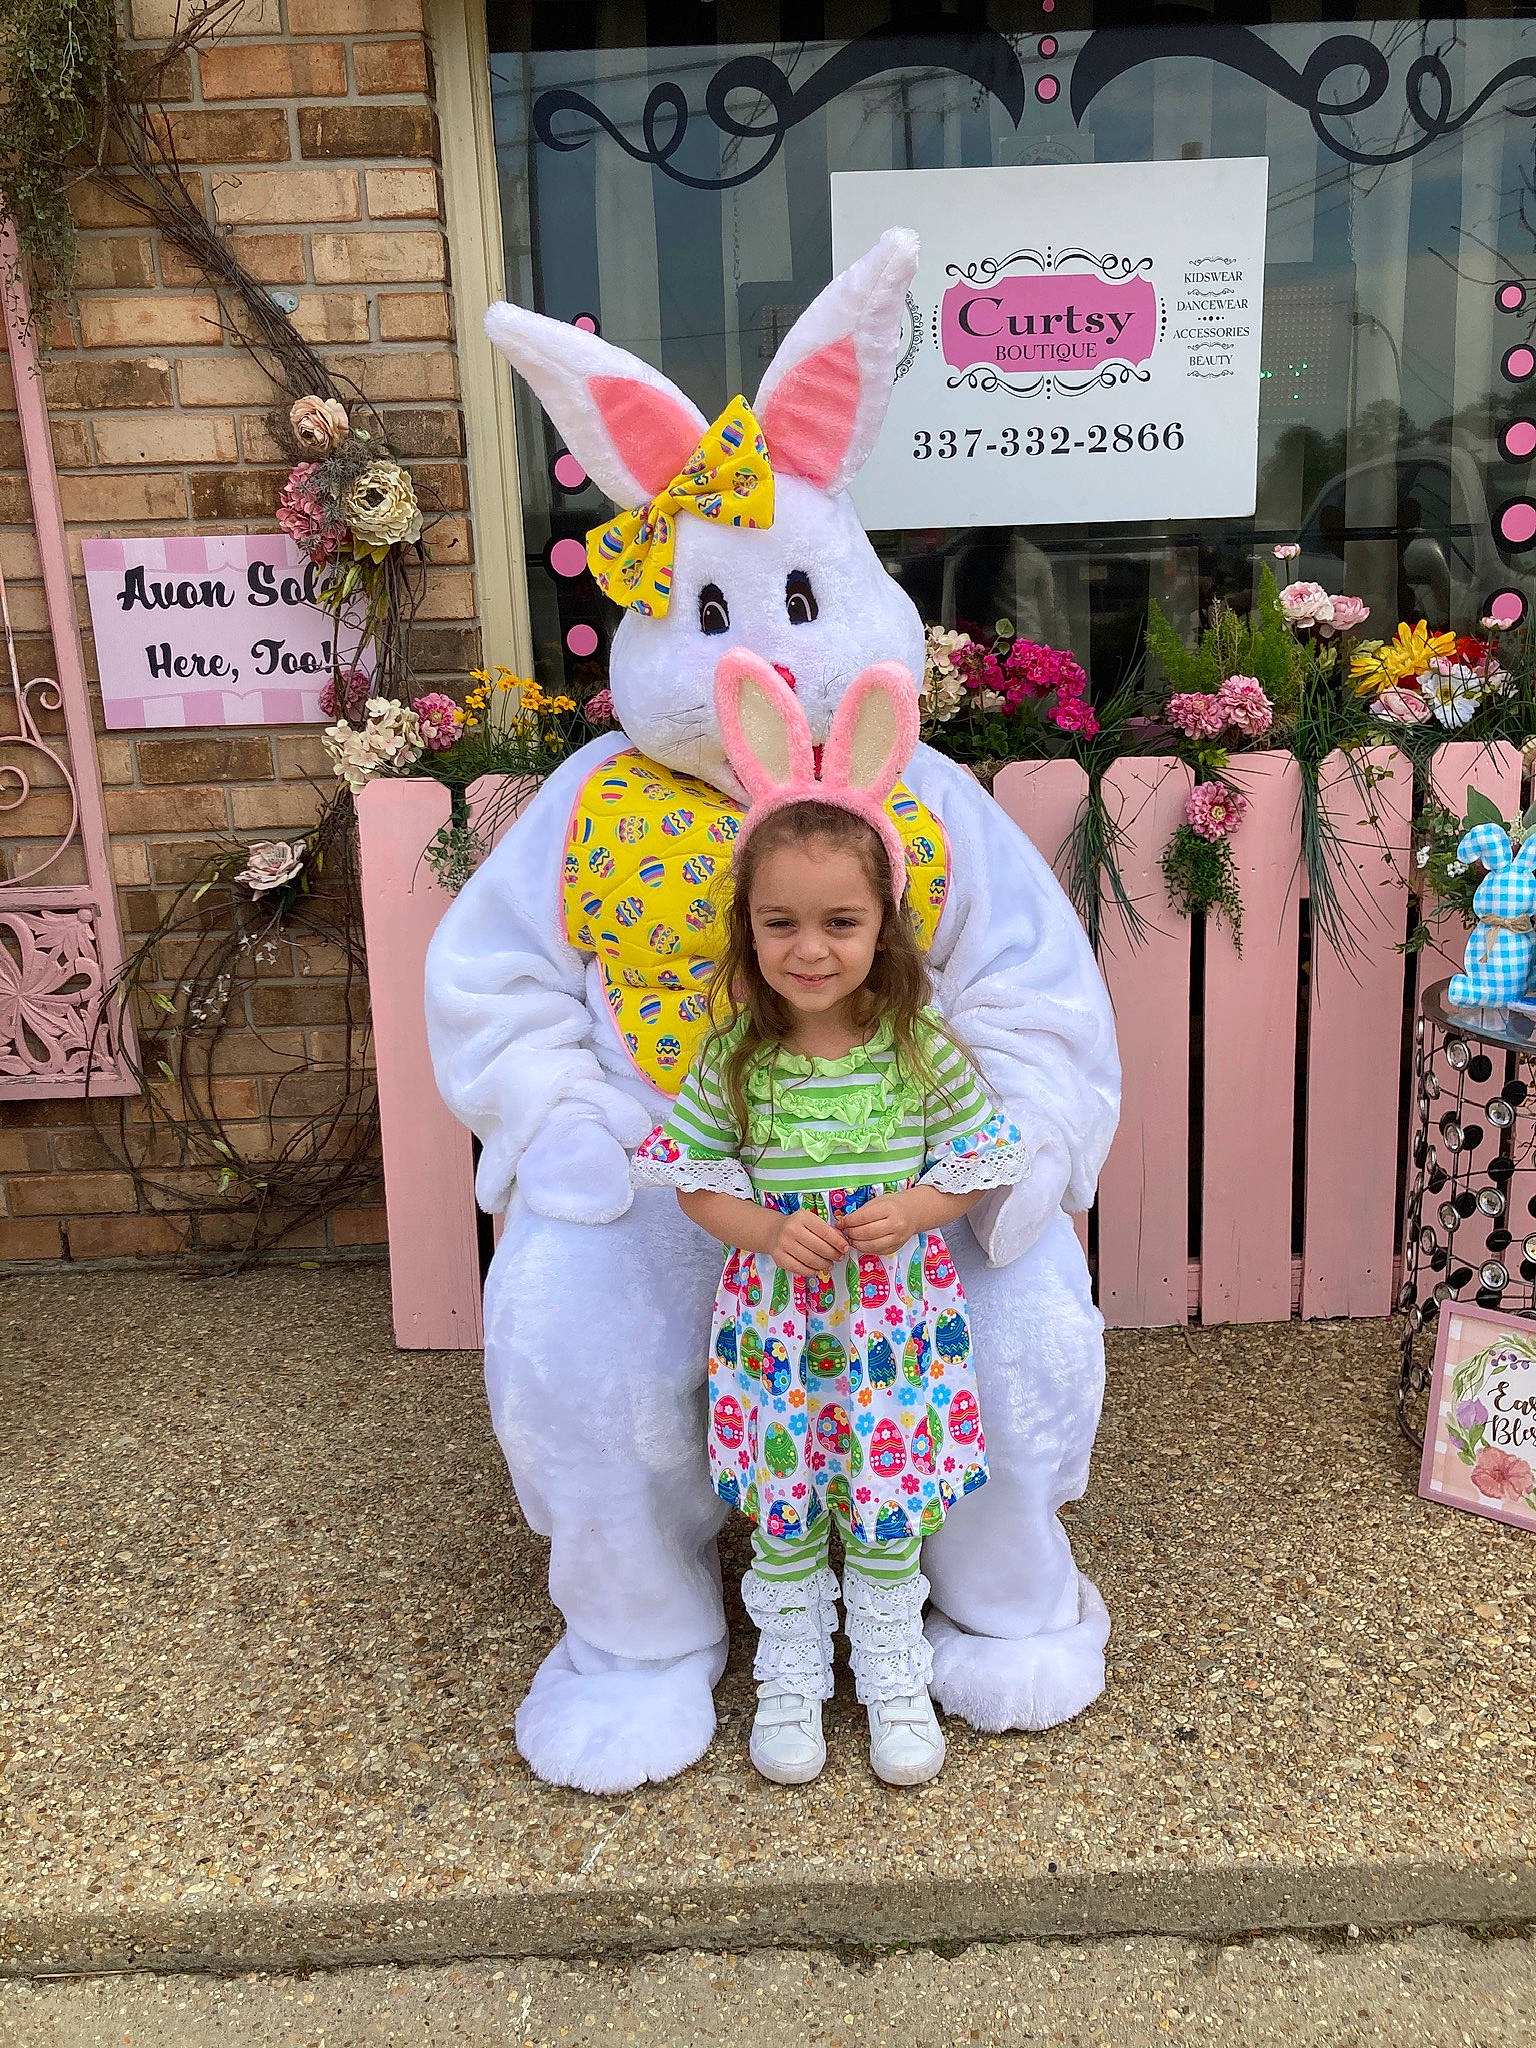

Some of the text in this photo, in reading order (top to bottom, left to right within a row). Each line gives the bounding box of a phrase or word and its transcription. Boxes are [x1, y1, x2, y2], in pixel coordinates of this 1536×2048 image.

[1184, 271, 1243, 283] KIDSWEAR
[1177, 299, 1249, 311] DANCEWEAR
[958, 296, 1135, 344] Curtsy
[1174, 327, 1250, 339] ACCESSORIES
[995, 343, 1097, 363] BOUTIQUE
[1189, 354, 1233, 366] BEAUTY
[912, 422, 1185, 460] 337-332-2866
[117, 565, 235, 611] Avon
[145, 638, 332, 683] Here, Too!
